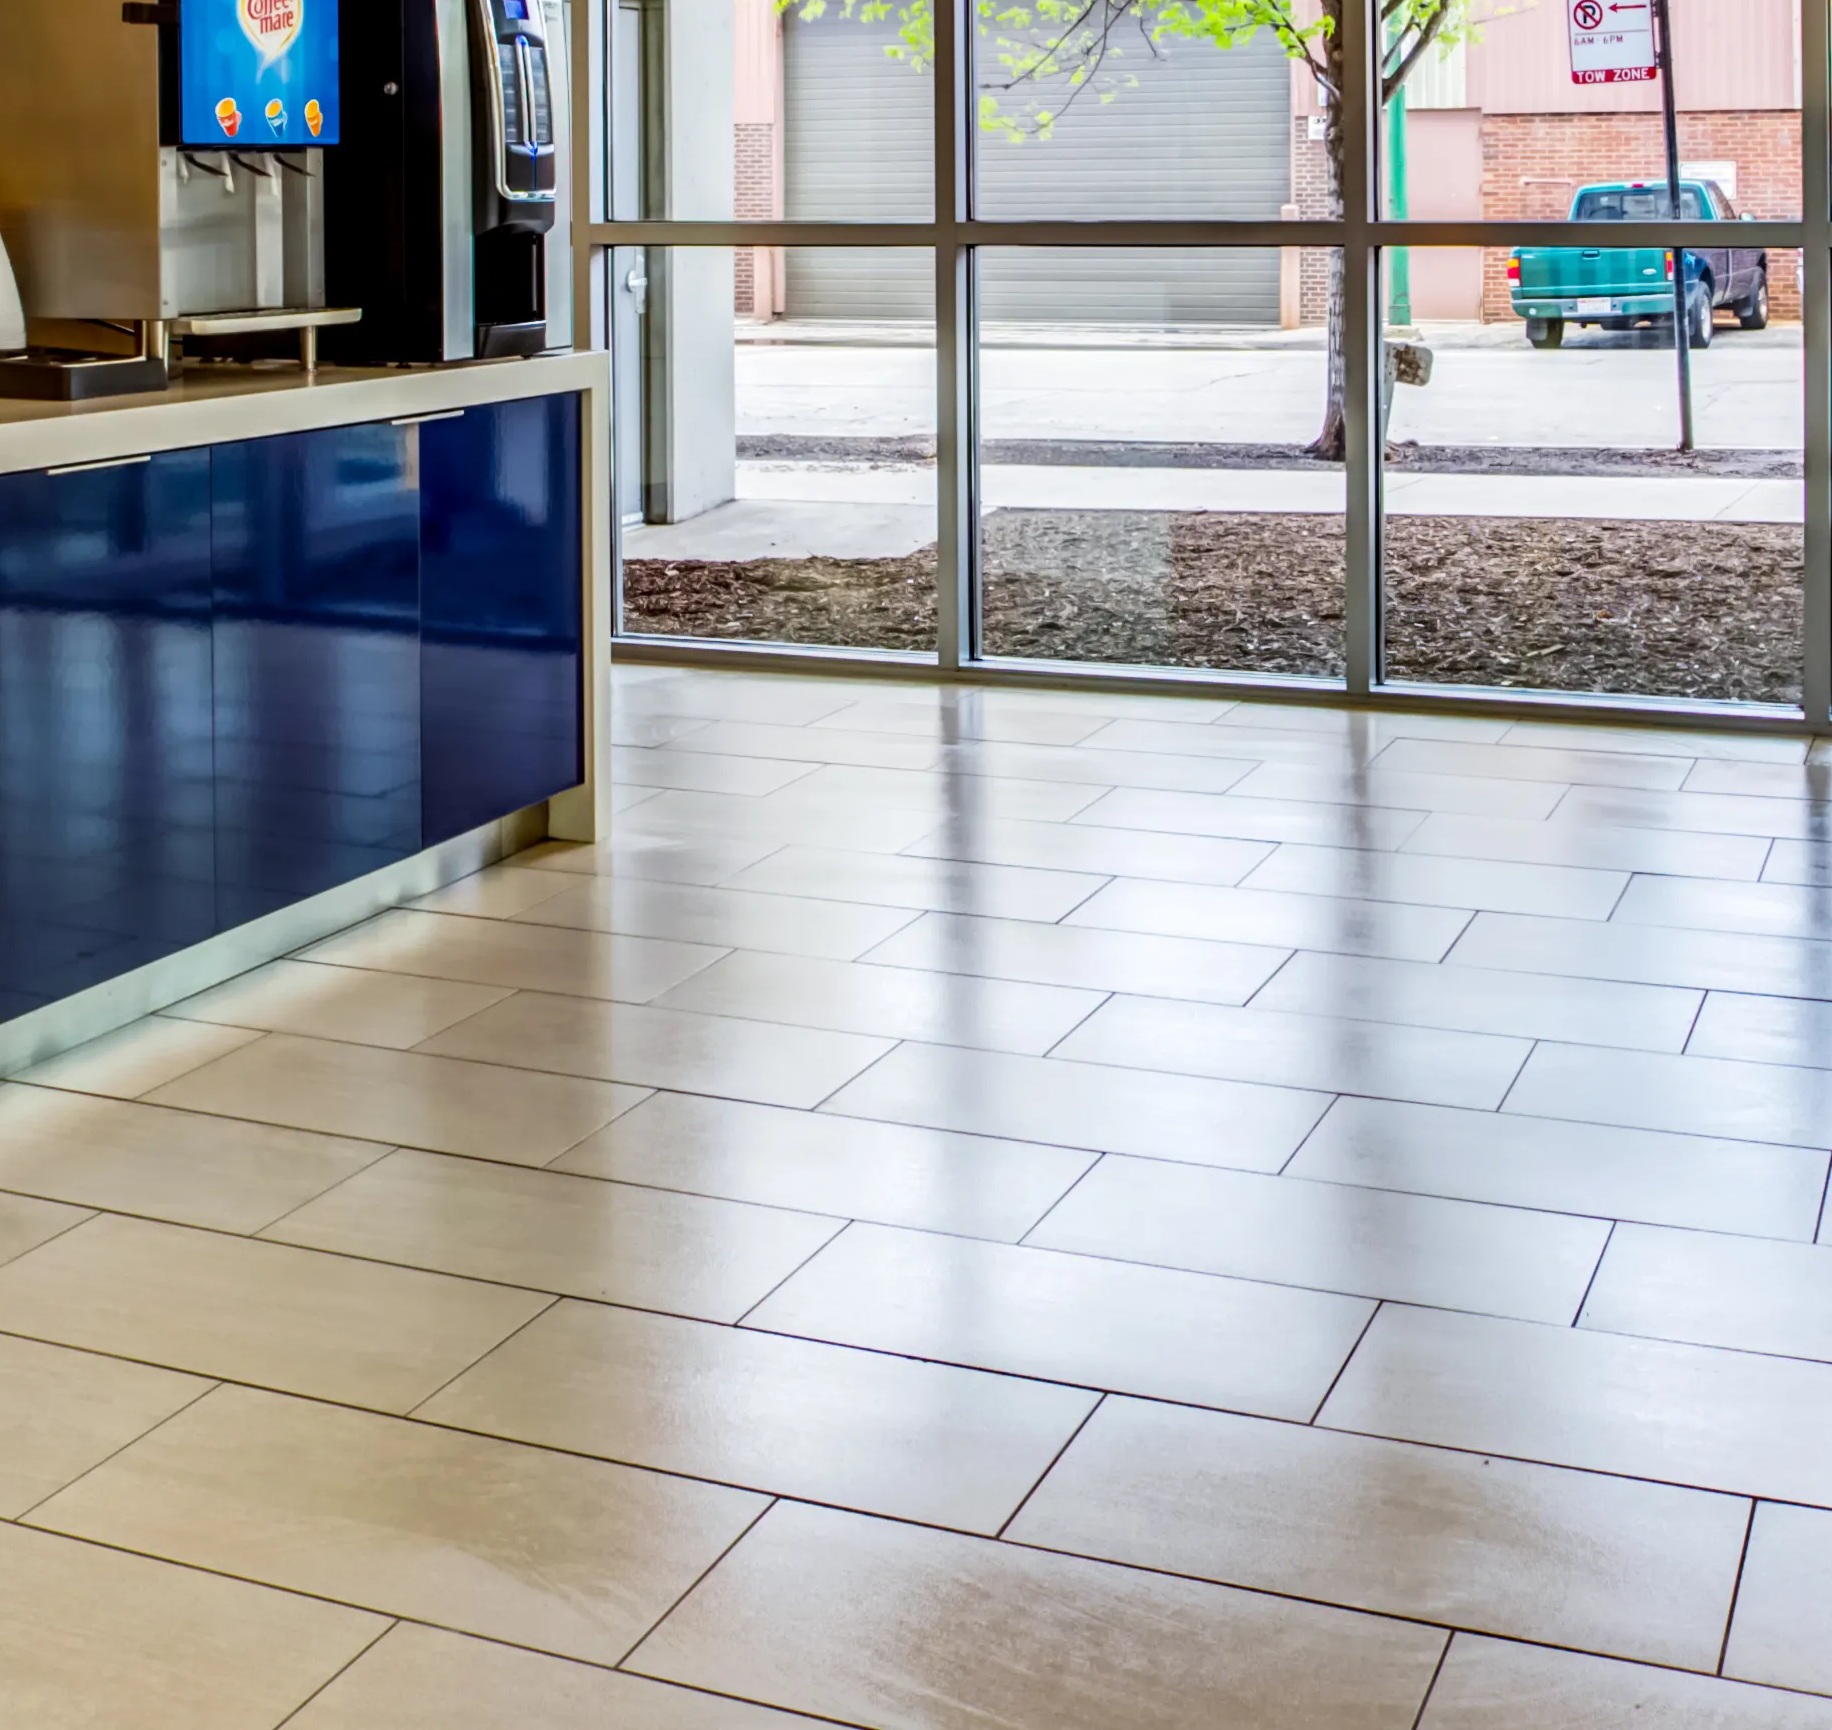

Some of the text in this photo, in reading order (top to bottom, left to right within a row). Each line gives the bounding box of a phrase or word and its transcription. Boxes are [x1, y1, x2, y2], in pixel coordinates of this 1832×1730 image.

[260, 10, 294, 35] mate
[1576, 67, 1649, 83] TOW ZONE
